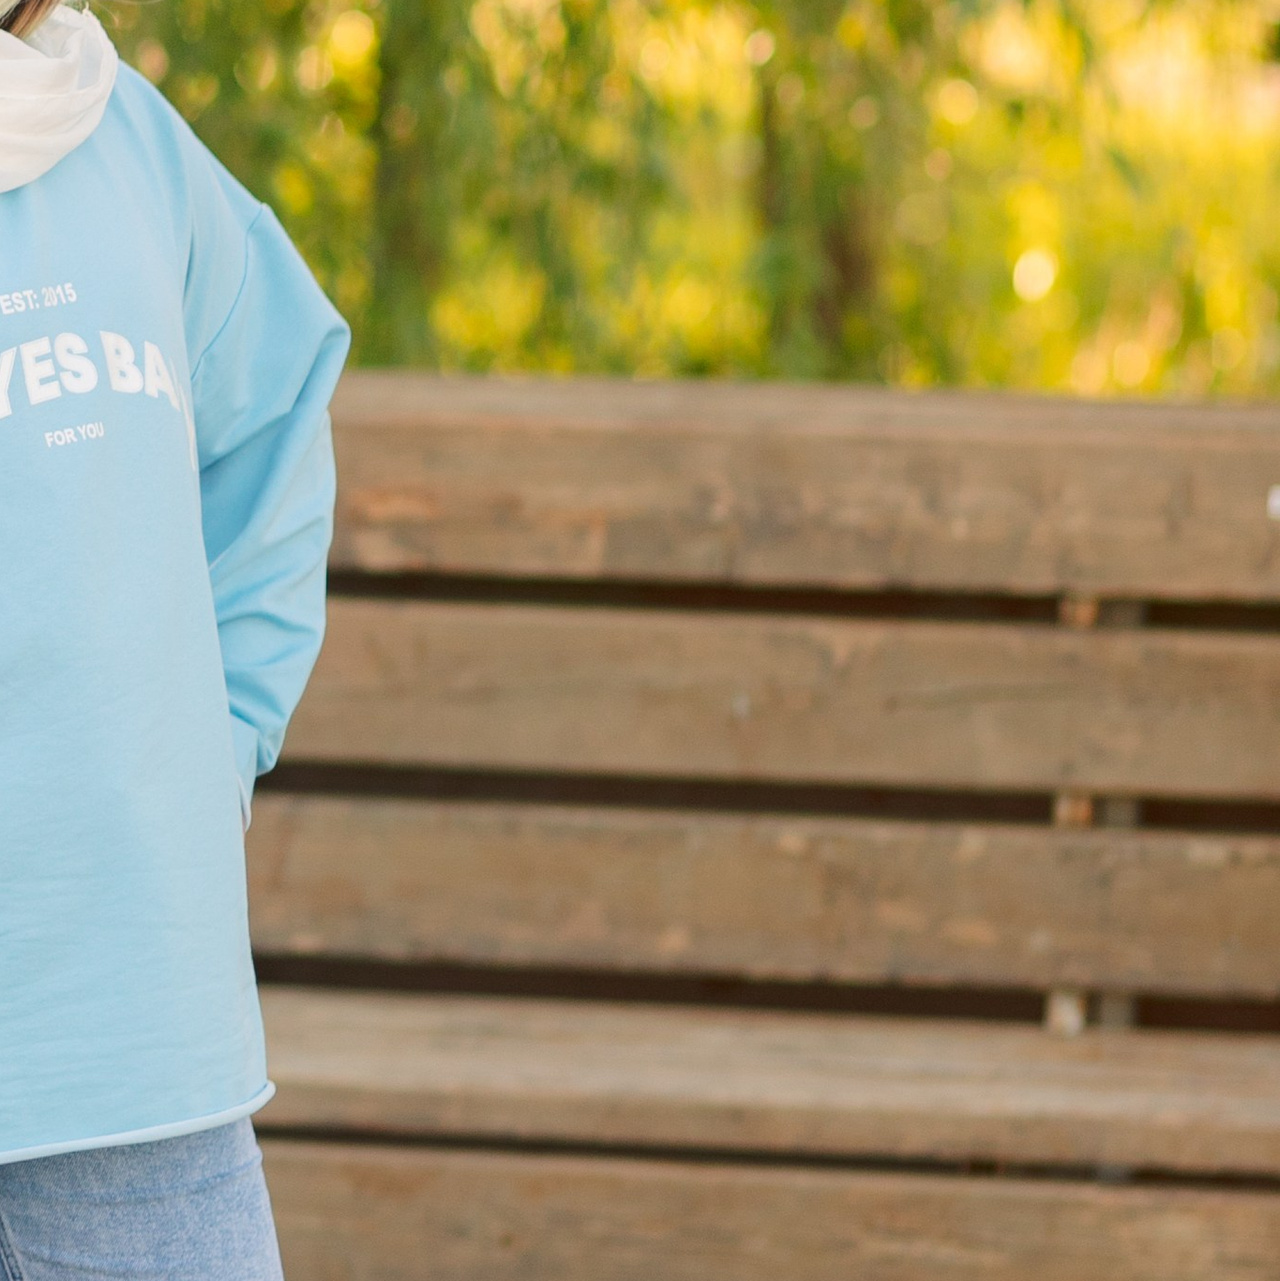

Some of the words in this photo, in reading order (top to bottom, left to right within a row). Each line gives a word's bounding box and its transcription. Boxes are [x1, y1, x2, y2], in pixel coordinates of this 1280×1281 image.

[44, 427, 78, 448] FOR
[76, 421, 105, 441] YOU
[99, 330, 196, 471] BA
